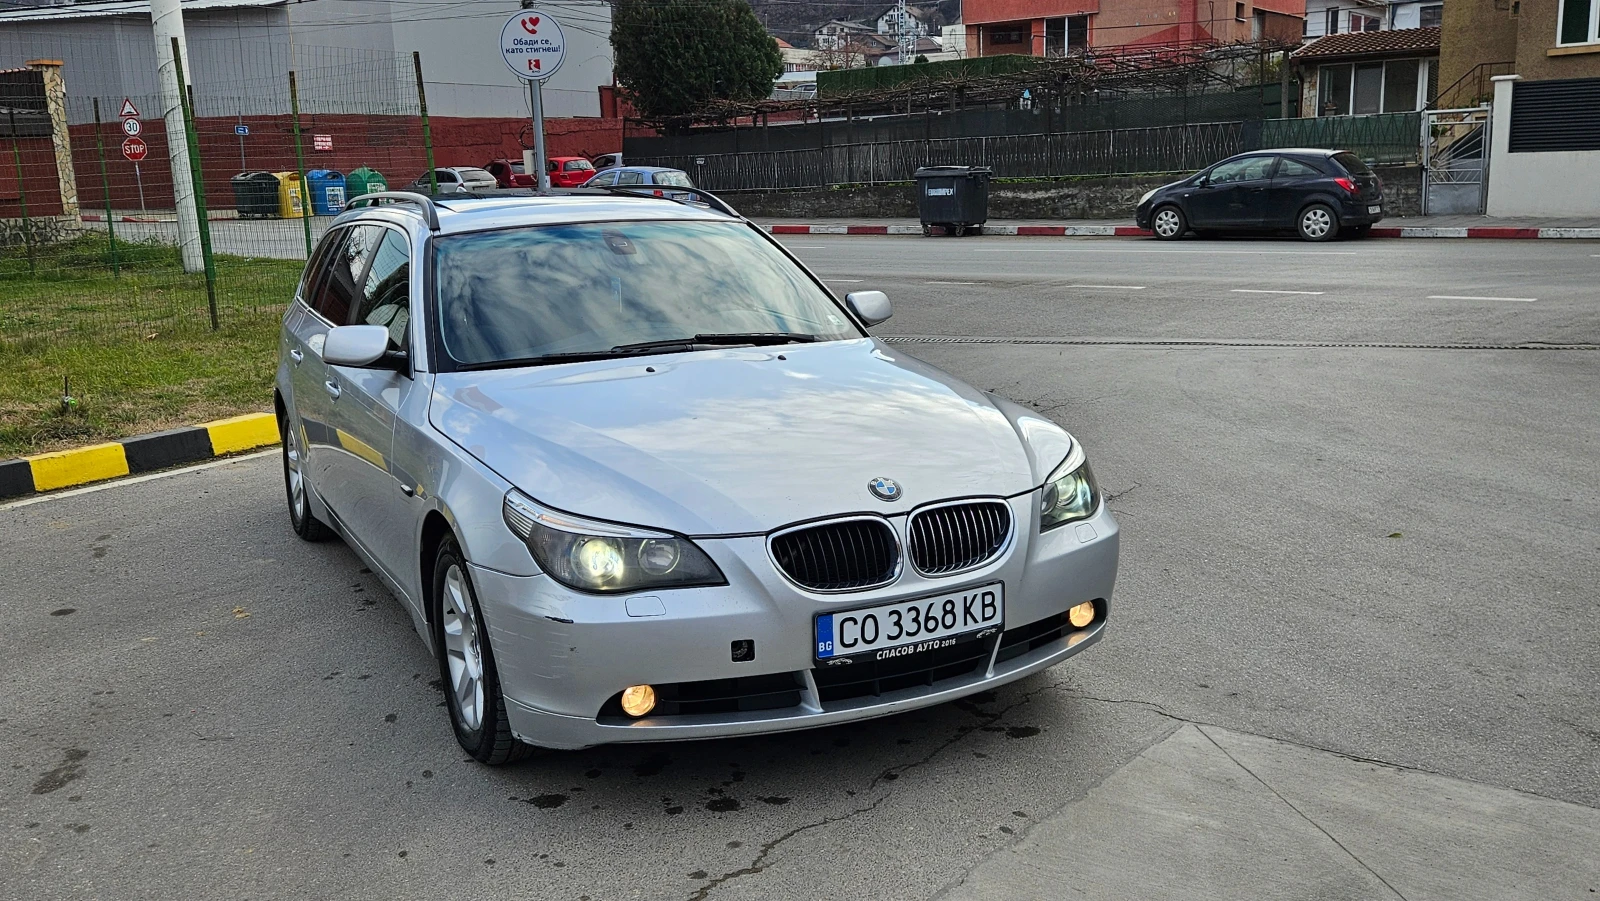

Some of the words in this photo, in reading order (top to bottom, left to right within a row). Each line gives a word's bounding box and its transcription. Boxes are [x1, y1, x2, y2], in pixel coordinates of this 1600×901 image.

[513, 38, 538, 46] Обади
[525, 45, 561, 53] стигнеш!
[126, 122, 138, 132] 30
[125, 143, 145, 154] STOP
[886, 599, 957, 641] 3368
[818, 640, 833, 652] BG
[876, 645, 915, 661] СПАСОВ
[916, 640, 940, 653] АУТО
[941, 638, 956, 648] 2016
